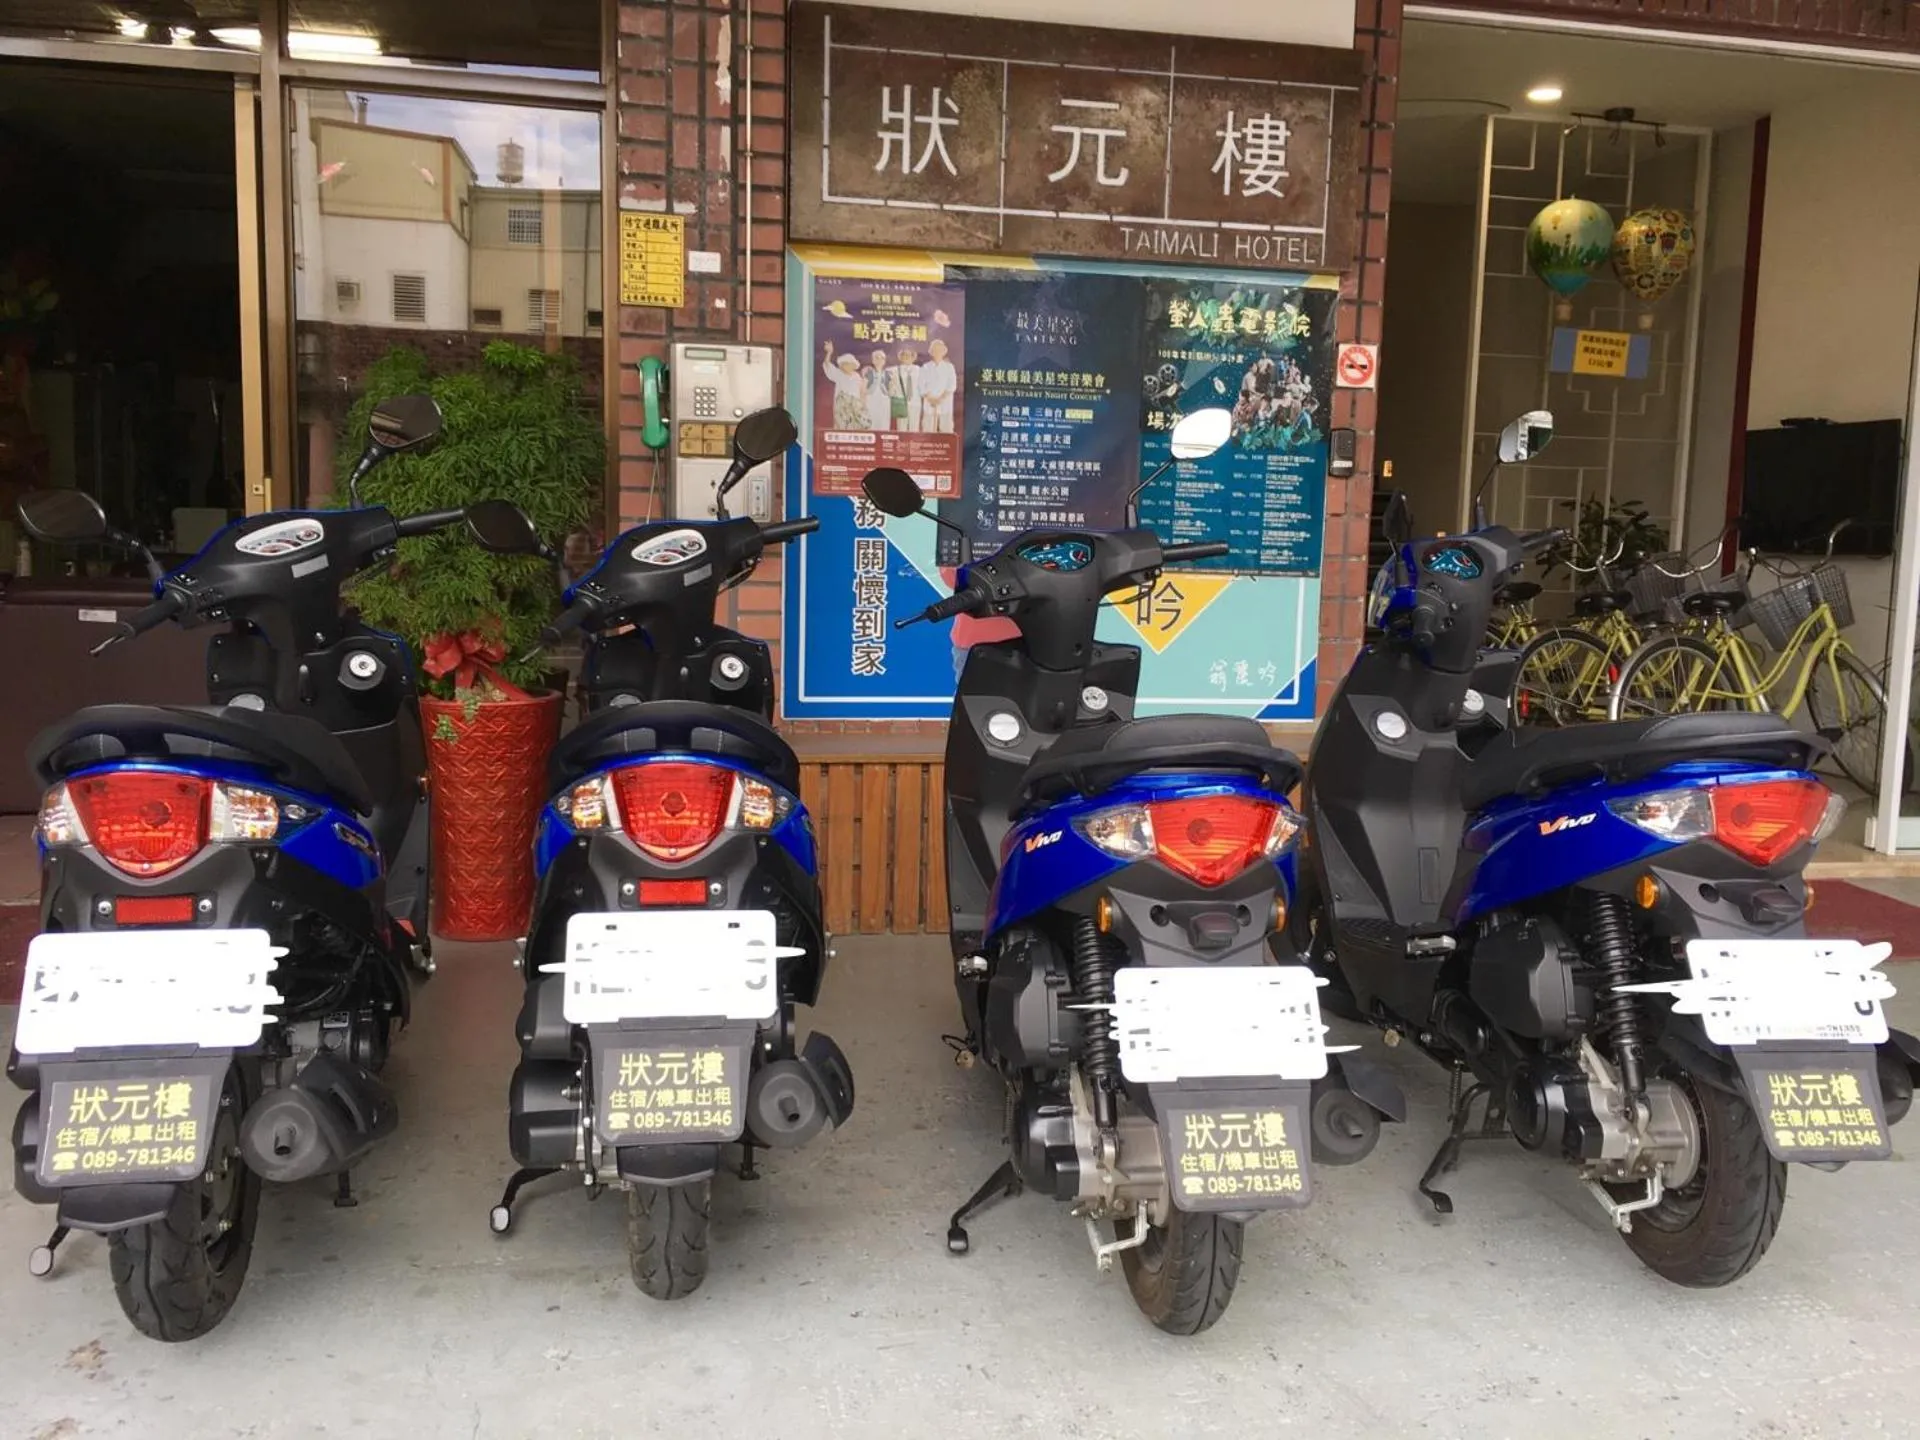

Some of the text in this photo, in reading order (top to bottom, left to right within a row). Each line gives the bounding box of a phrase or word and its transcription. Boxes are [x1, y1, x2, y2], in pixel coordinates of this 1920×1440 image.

[874, 84, 1292, 199] 狀元樓
[1119, 226, 1317, 265] TAIMALI HOTEL
[853, 318, 928, 343] 點亮幸福
[852, 538, 887, 676] 關懷到家
[618, 1051, 725, 1087] 狀元樓
[68, 1082, 194, 1125] 狀元樓
[608, 1087, 732, 1110] 住宿/機車出租
[1769, 1073, 1863, 1107] 狀元樓
[633, 1110, 733, 1130] 089-781346
[1184, 1112, 1288, 1149] 狀元樓
[55, 1121, 197, 1149] 住宿/機車出租
[1798, 1130, 1882, 1148] 089-781346
[81, 1146, 197, 1168] 089-781346
[1180, 1149, 1300, 1174] 住宿/機車出租
[1207, 1174, 1302, 1195] 089-781346
